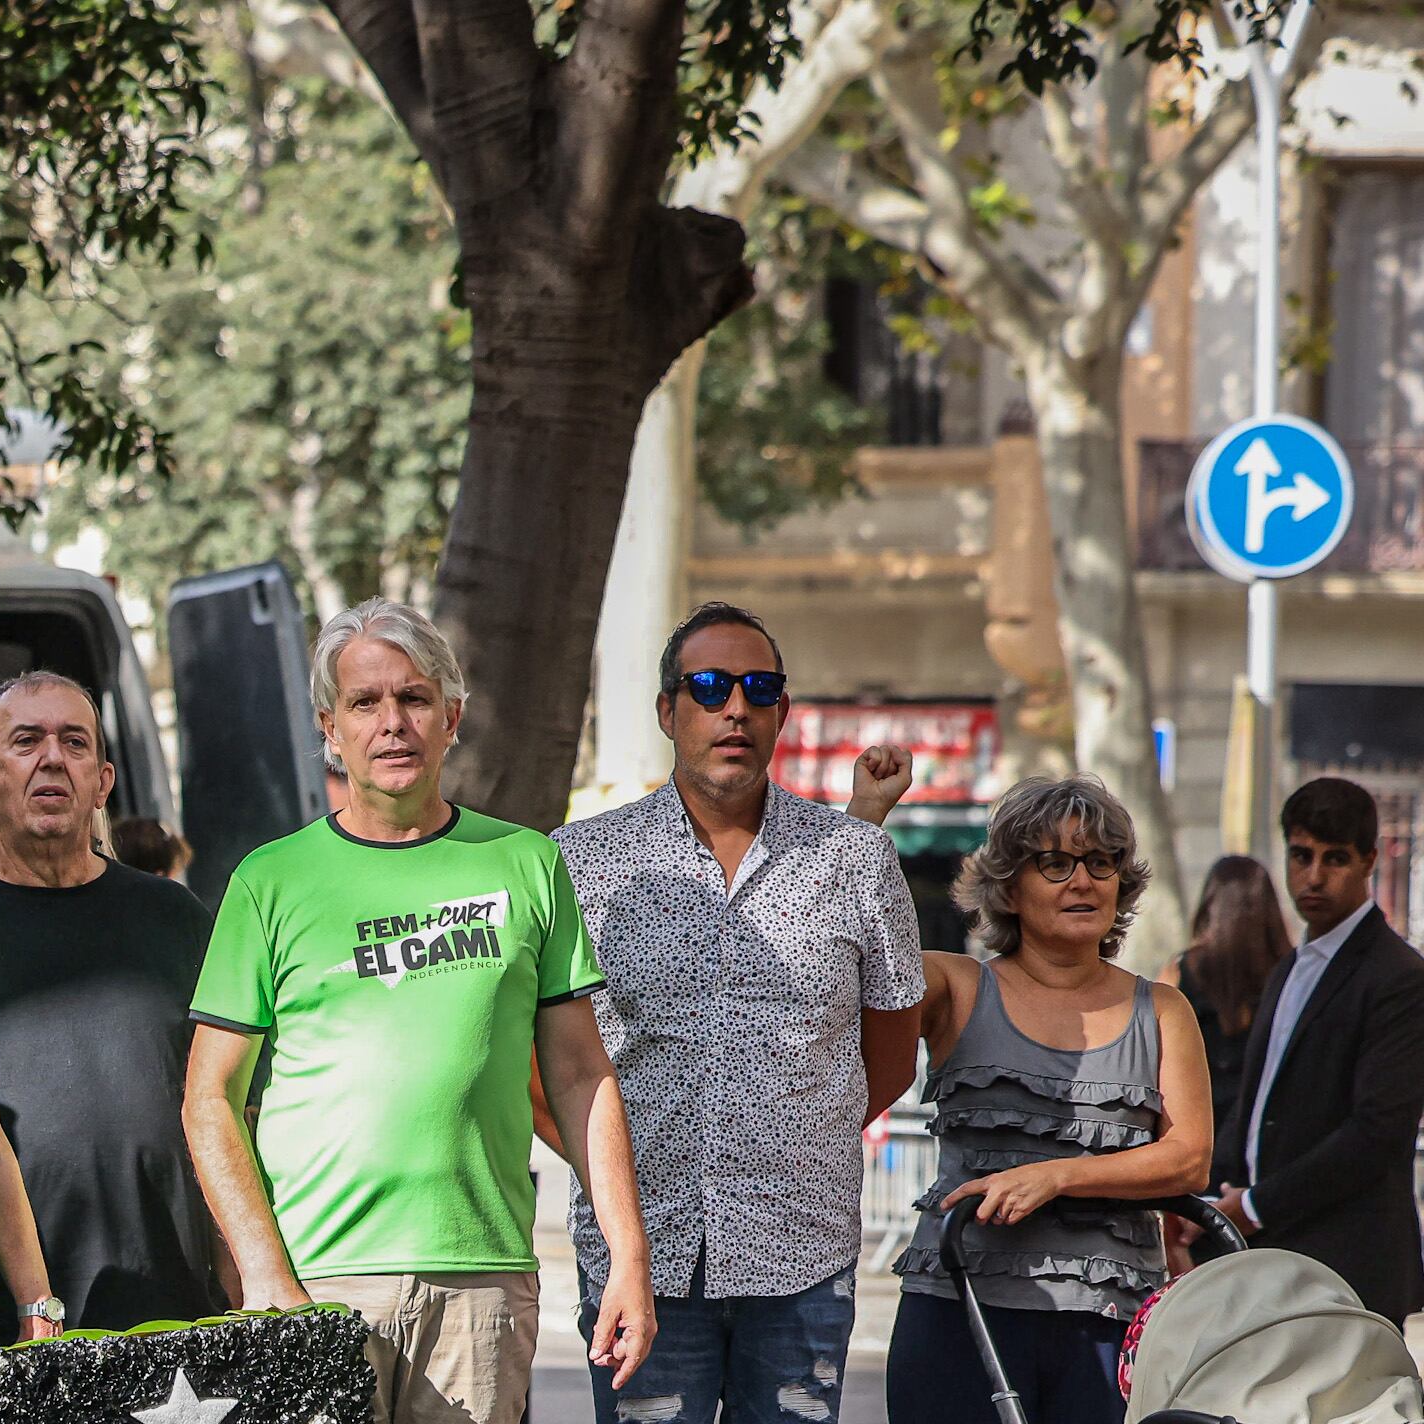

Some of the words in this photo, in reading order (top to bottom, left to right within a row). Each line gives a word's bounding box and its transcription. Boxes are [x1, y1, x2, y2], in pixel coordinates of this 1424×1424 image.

[356, 913, 419, 941] FEM
[353, 942, 397, 979] EL
[400, 926, 502, 971] CAMÍ
